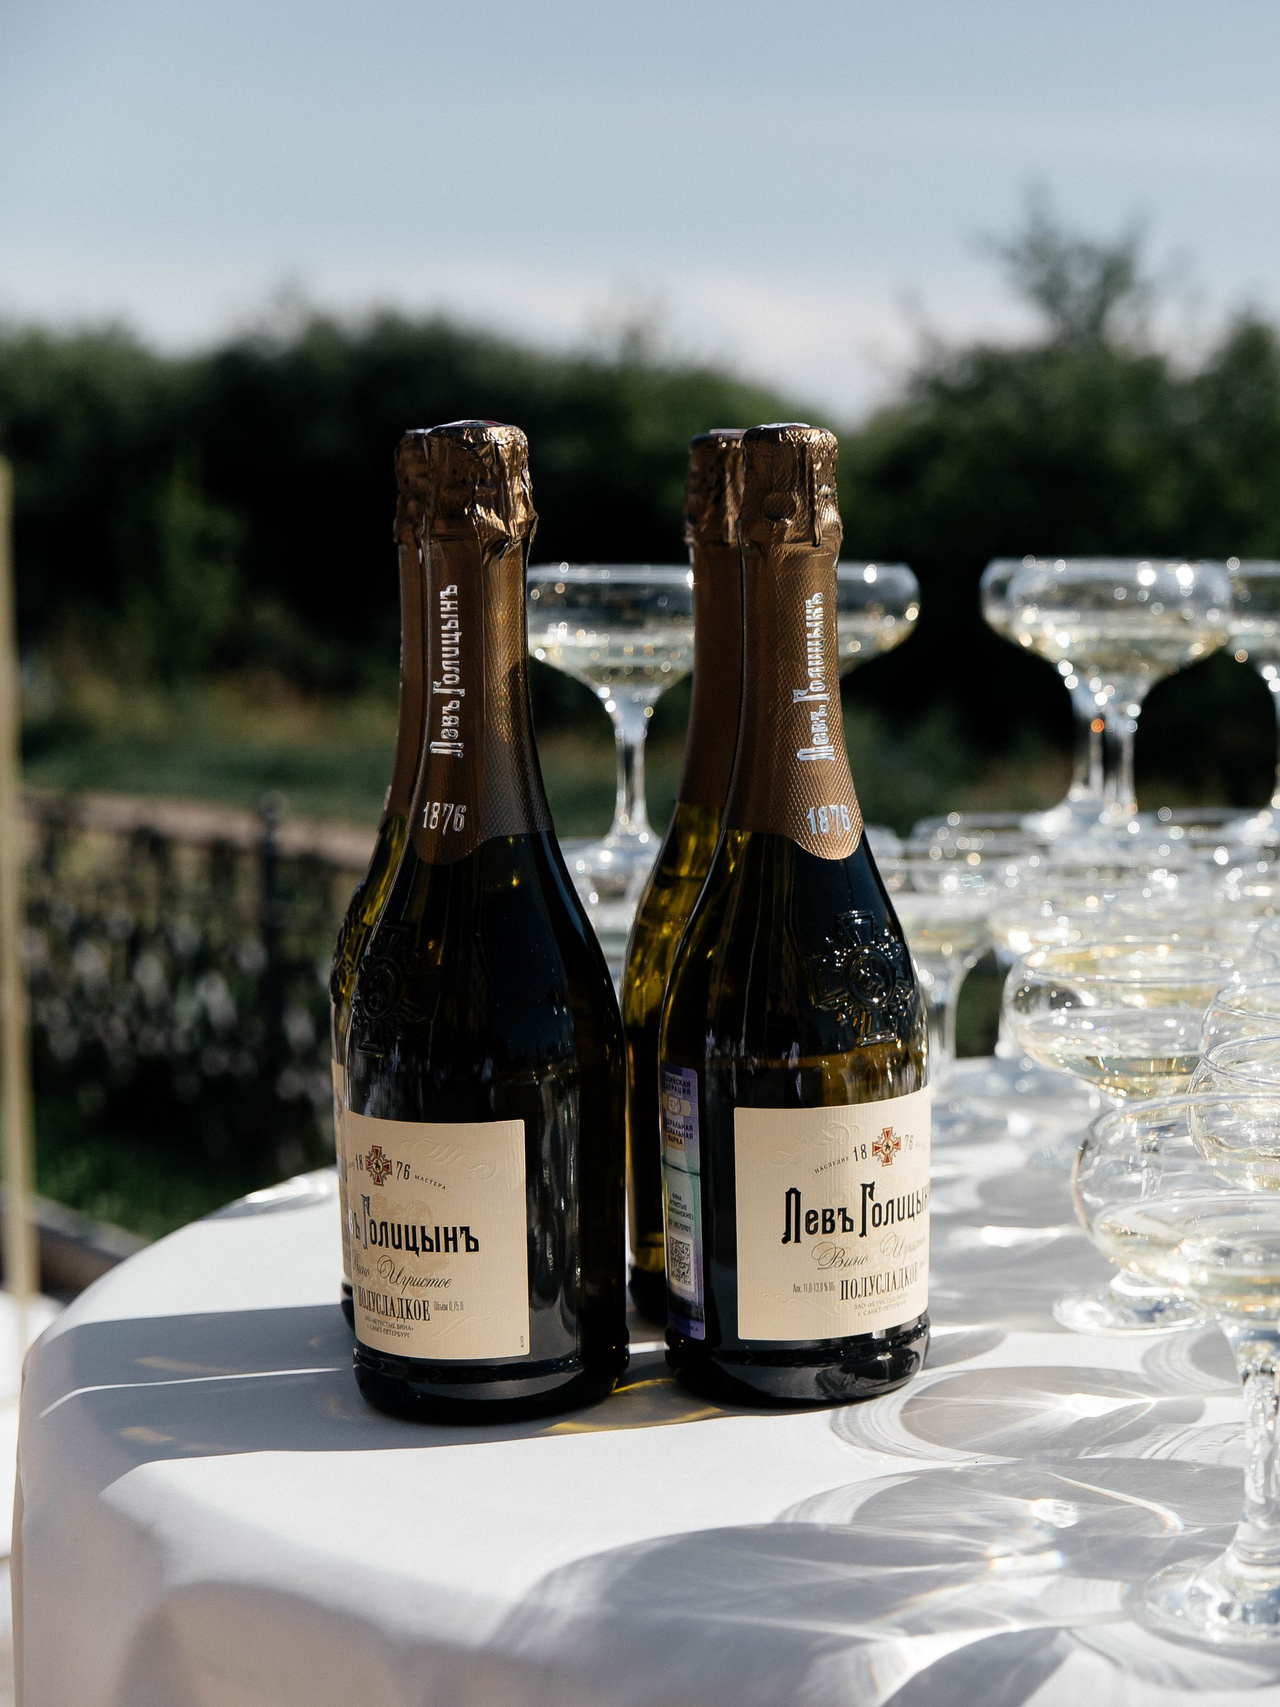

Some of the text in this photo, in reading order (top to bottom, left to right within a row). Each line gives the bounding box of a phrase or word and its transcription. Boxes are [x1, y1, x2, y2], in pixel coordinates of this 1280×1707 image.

[430, 584, 466, 758] Левъ Голицынъ
[792, 591, 836, 762] Левъ Голицынъ
[422, 801, 467, 836] 1876
[806, 804, 851, 837] 1876
[355, 1154, 364, 1171] 18
[396, 1160, 411, 1181] 76
[414, 1174, 447, 1191] МАСТЕРА
[813, 1156, 850, 1175] НАСЛЕДИЕ
[852, 1143, 868, 1162] 18
[361, 1193, 480, 1258] Голицынъ
[781, 1187, 855, 1245] Левъ
[376, 1254, 453, 1295] Игристое
[810, 1240, 869, 1271] Вино
[839, 1261, 919, 1301] ПОЛУСЛАДКОЕ
[357, 1284, 432, 1323] ПОЛУСЛАДКОЕ
